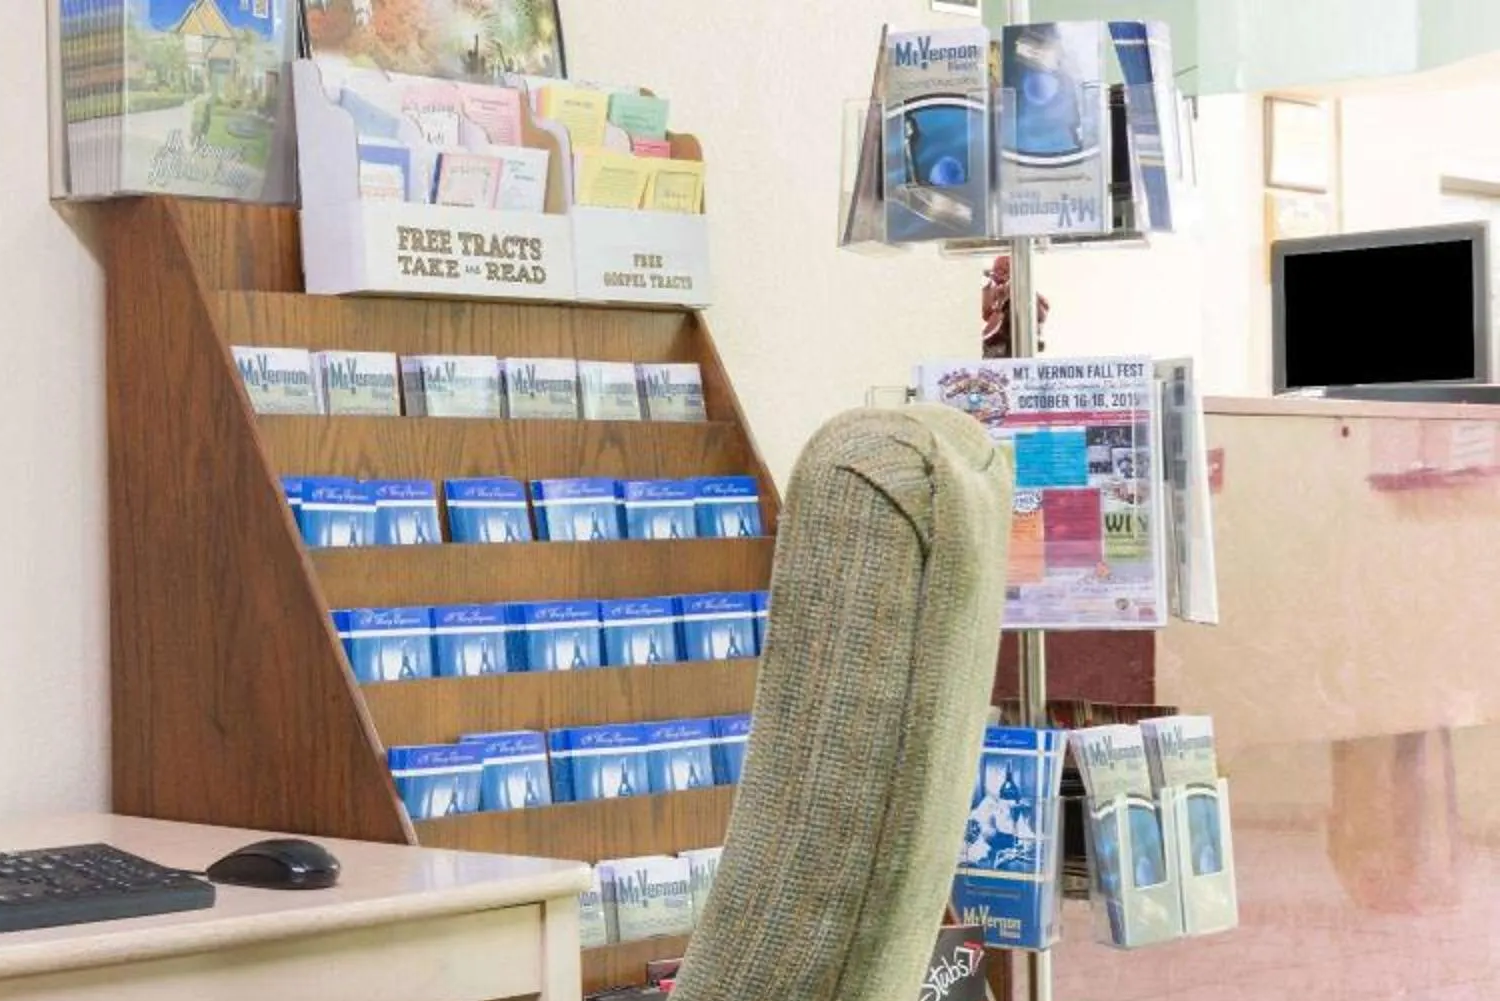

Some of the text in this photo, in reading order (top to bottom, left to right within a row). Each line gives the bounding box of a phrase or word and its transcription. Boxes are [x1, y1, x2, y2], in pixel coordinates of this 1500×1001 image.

[396, 226, 542, 261] FREE TRACTS
[398, 255, 460, 278] TAKE
[485, 261, 547, 284] READ
[633, 253, 663, 269] FREE
[603, 271, 693, 290] GOSPEL TRACTS
[1038, 364, 1084, 379] VERNON
[1087, 363, 1114, 378] FALL
[1116, 363, 1144, 377] FEST
[1018, 393, 1069, 409] OCTOBER
